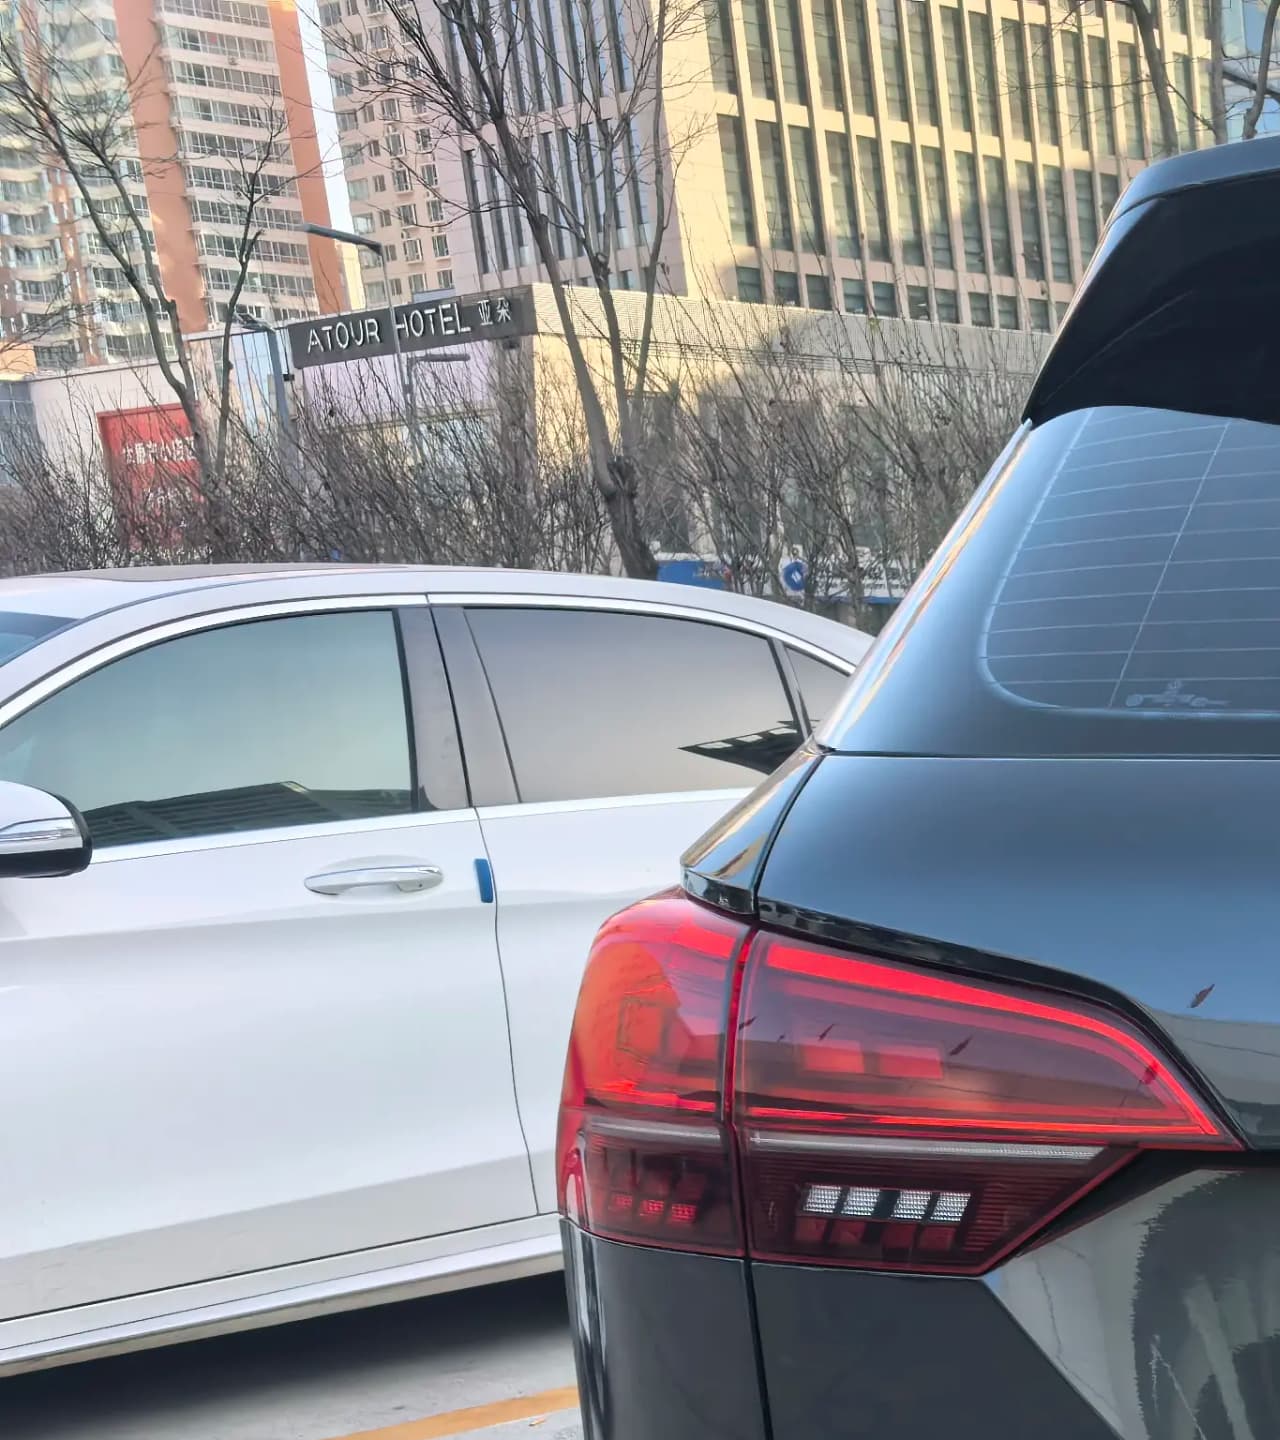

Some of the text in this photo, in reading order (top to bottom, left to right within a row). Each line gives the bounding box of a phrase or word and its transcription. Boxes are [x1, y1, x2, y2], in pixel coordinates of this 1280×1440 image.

[307, 302, 471, 353] ATOUR HOTEL
[478, 297, 512, 326] 亚朵
